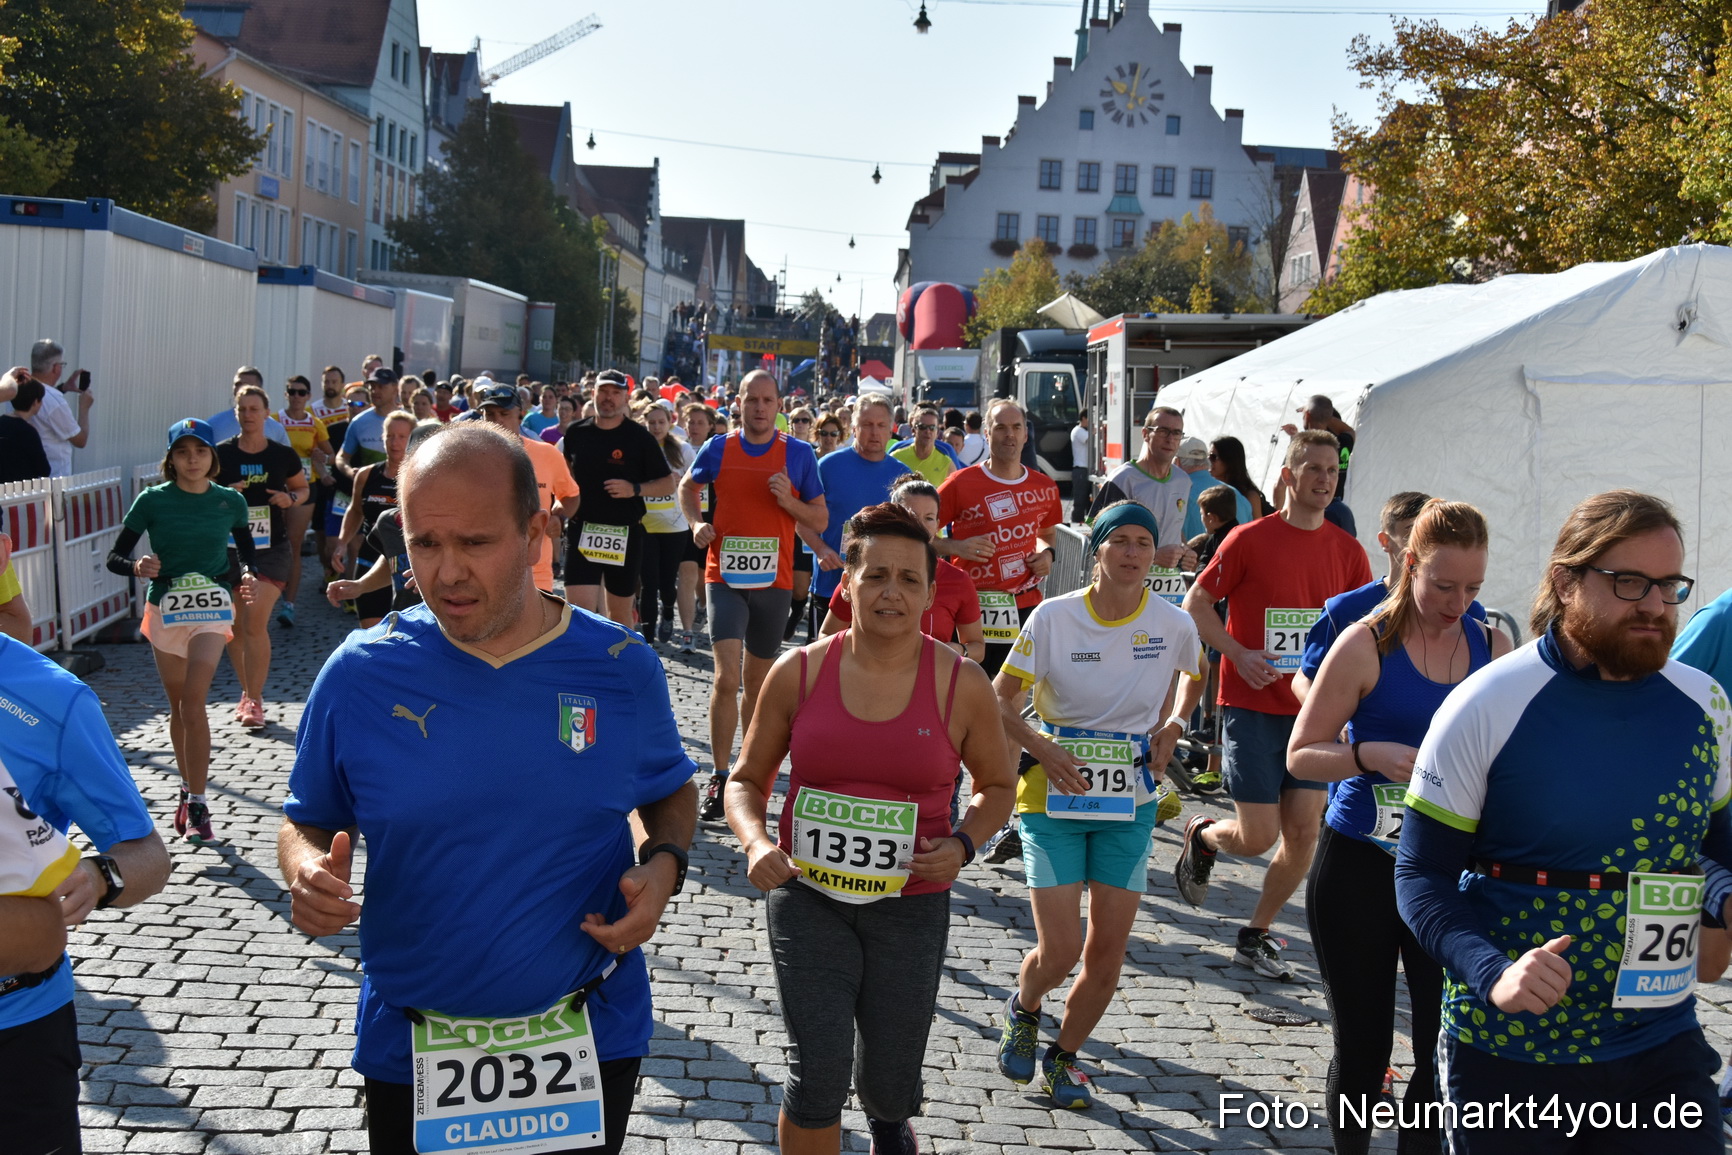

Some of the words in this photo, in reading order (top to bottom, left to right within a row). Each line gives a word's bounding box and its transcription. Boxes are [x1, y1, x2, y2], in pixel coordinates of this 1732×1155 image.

[744, 340, 783, 350] START
[241, 464, 262, 475] RUN
[587, 536, 621, 551] 1036
[725, 539, 773, 551] BOCK
[583, 550, 619, 560] MATTHIAS
[726, 555, 771, 570] 2807
[1143, 579, 1181, 592] 2017
[167, 591, 222, 611] 2265
[979, 594, 1009, 606] OCK
[174, 612, 221, 621] SABRINA
[1013, 635, 1033, 657] 20
[1133, 634, 1148, 645] 20
[1274, 632, 1308, 651] 21
[1134, 652, 1160, 660] Stadtlauf
[564, 698, 591, 706] ITALIA
[1067, 795, 1100, 809] Lisa
[803, 794, 904, 831] BOCK
[806, 828, 897, 870] 1333
[808, 867, 887, 892] KATHRIN
[428, 1005, 572, 1047] BOCK
[437, 1051, 577, 1108] 2032
[579, 1050, 587, 1059] D
[444, 1111, 570, 1144] CLAUDIO
